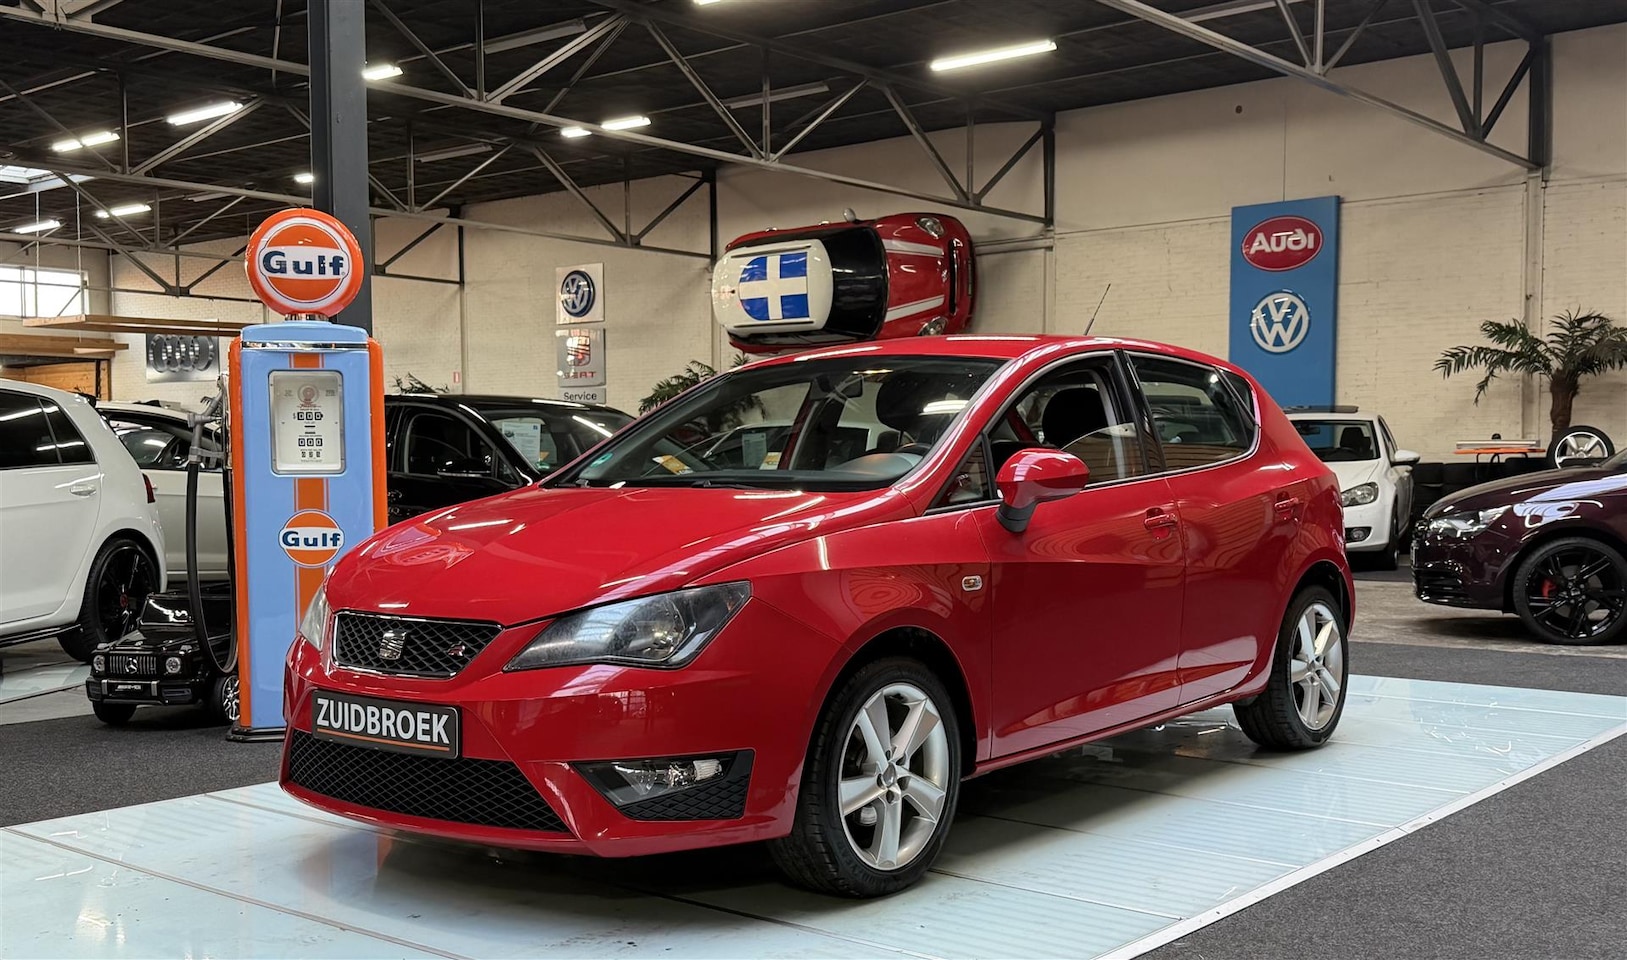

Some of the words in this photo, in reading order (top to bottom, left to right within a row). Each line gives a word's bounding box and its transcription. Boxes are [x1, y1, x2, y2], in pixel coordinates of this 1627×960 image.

[262, 250, 344, 276] Gulf
[1251, 292, 1309, 353] VW
[563, 391, 598, 401] Service
[282, 530, 341, 547] Gulf
[316, 698, 450, 744] ZUIDBROEK
